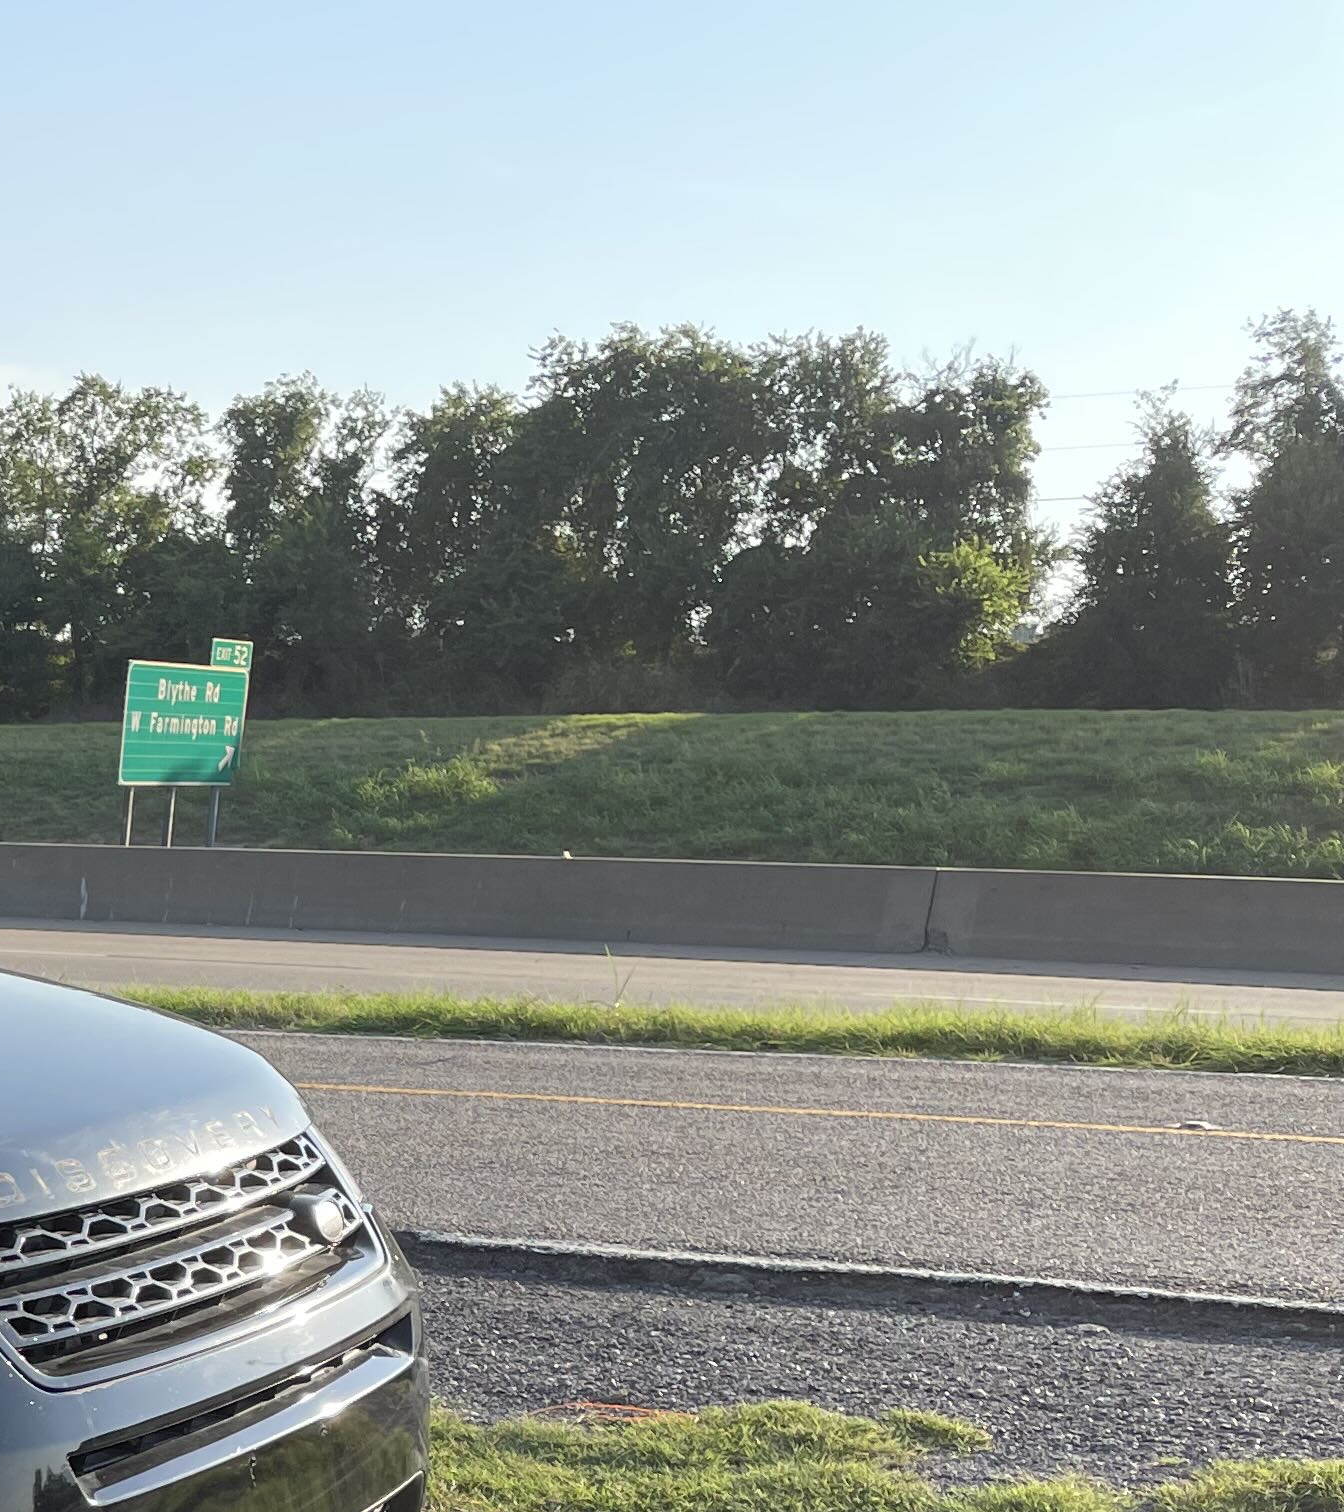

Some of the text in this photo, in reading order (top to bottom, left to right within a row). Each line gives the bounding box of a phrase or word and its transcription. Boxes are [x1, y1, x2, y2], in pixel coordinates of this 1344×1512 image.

[234, 645, 248, 666] 52
[158, 678, 220, 705] Blythe Rd
[131, 711, 238, 739] W Farmington Rd
